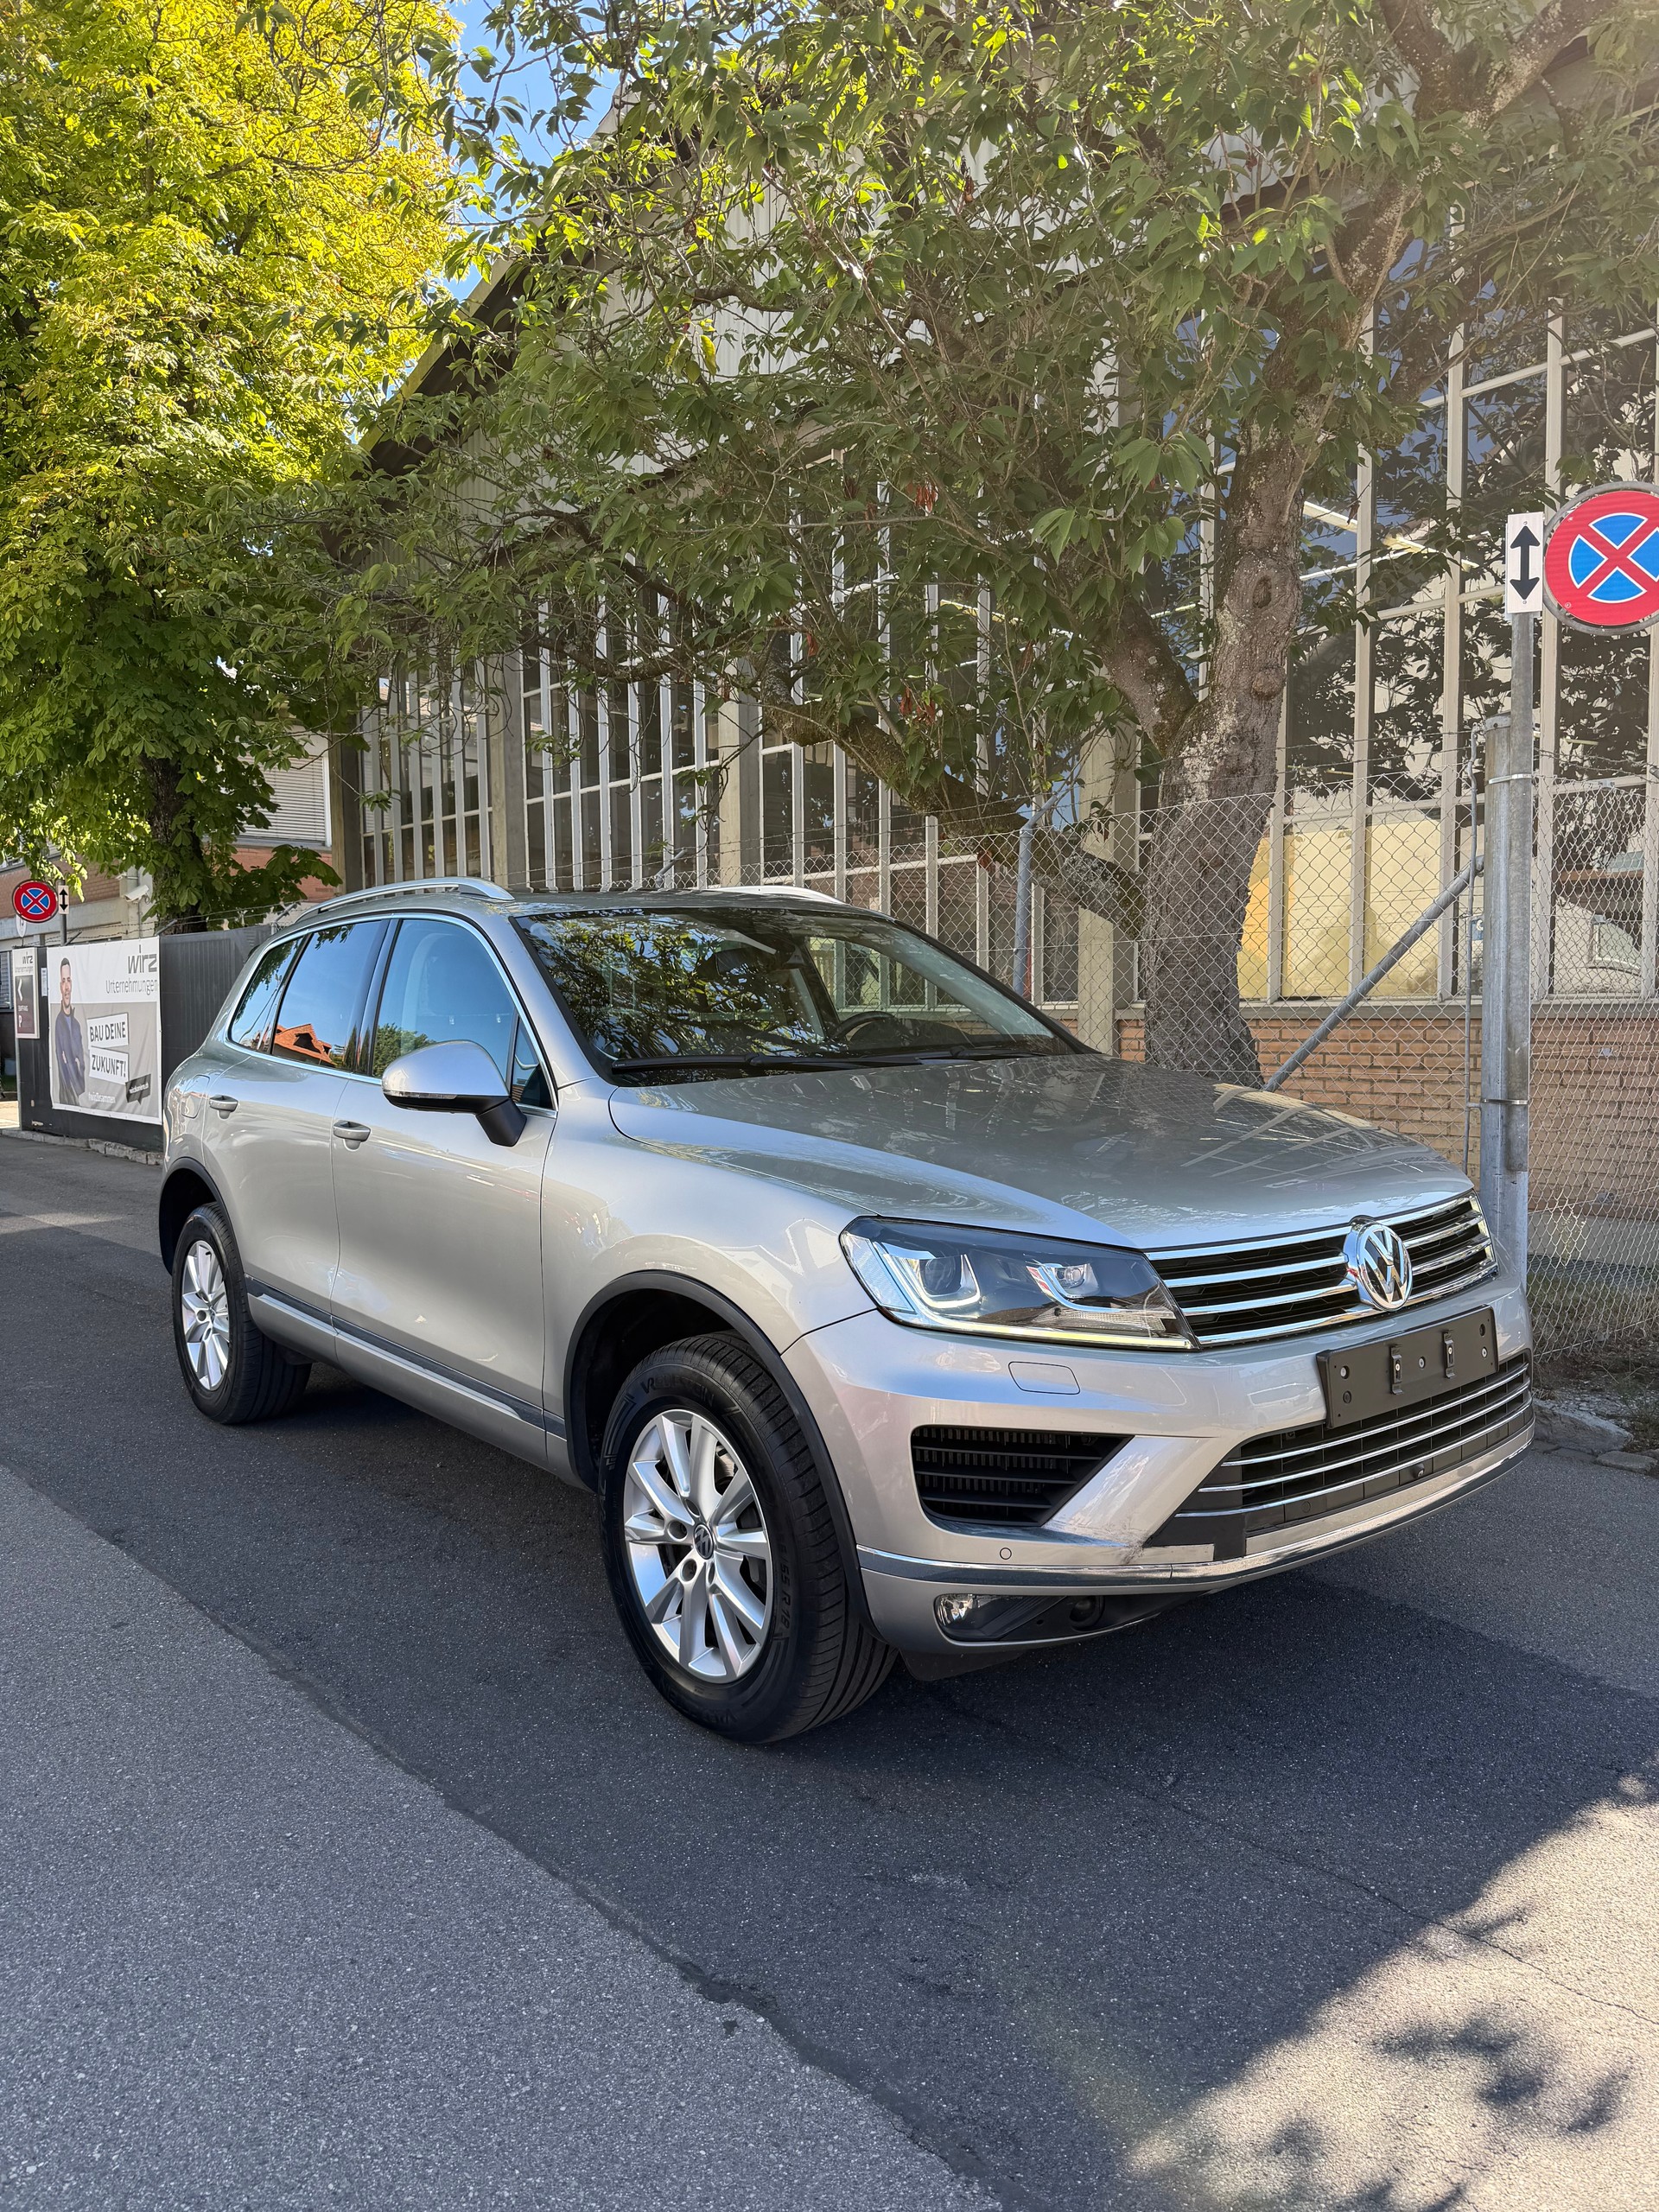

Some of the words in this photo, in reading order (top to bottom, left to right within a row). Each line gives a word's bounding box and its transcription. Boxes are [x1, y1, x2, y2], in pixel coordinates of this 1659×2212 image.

[128, 944, 157, 974] wirz
[90, 1024, 104, 1042] BAU
[105, 1021, 126, 1040] DEINE
[92, 1054, 126, 1077] ZUKUNFT!
